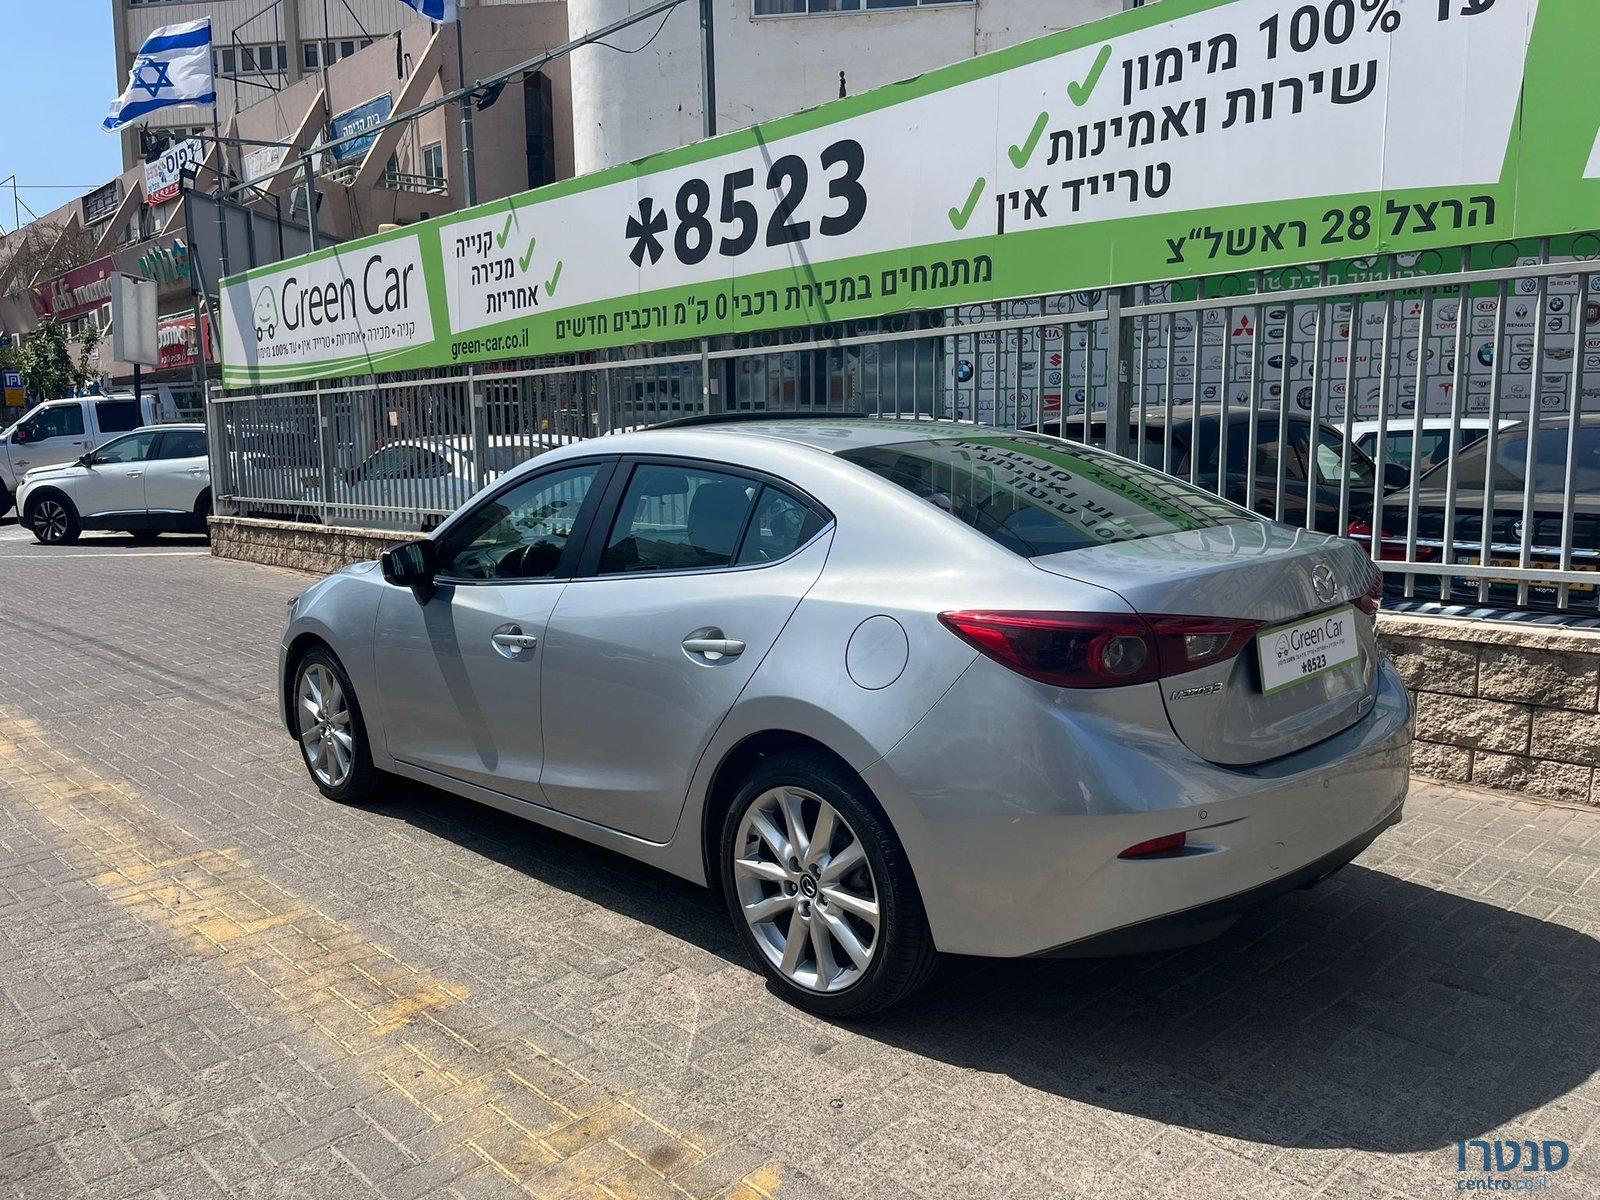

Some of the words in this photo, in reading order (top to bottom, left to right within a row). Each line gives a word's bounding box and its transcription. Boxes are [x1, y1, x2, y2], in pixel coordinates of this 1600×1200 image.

[1122, 33, 1238, 106] מימון
[1222, 60, 1377, 129] שירות
[1047, 97, 1206, 166] ואמינות
[1061, 162, 1171, 212] טרייד
[996, 185, 1049, 235] אין
[1320, 205, 1371, 245] 28
[1386, 195, 1495, 236] הרצל
[456, 231, 493, 258] קנייה
[471, 258, 514, 285] מכירה
[881, 254, 993, 294] מתמחים
[282, 277, 356, 331] Green
[363, 254, 413, 315] Car
[486, 285, 538, 314] אחריות
[716, 293, 727, 318] 0
[732, 289, 777, 317] רכבי
[785, 275, 873, 310] במכירת
[368, 325, 390, 343] מכירה
[397, 321, 415, 340] קניה
[556, 313, 607, 339] חדשים
[613, 305, 667, 332] ורכבים
[451, 328, 529, 357] green-car.co.il
[1290, 629, 1324, 651] Green
[1325, 618, 1343, 639] Car
